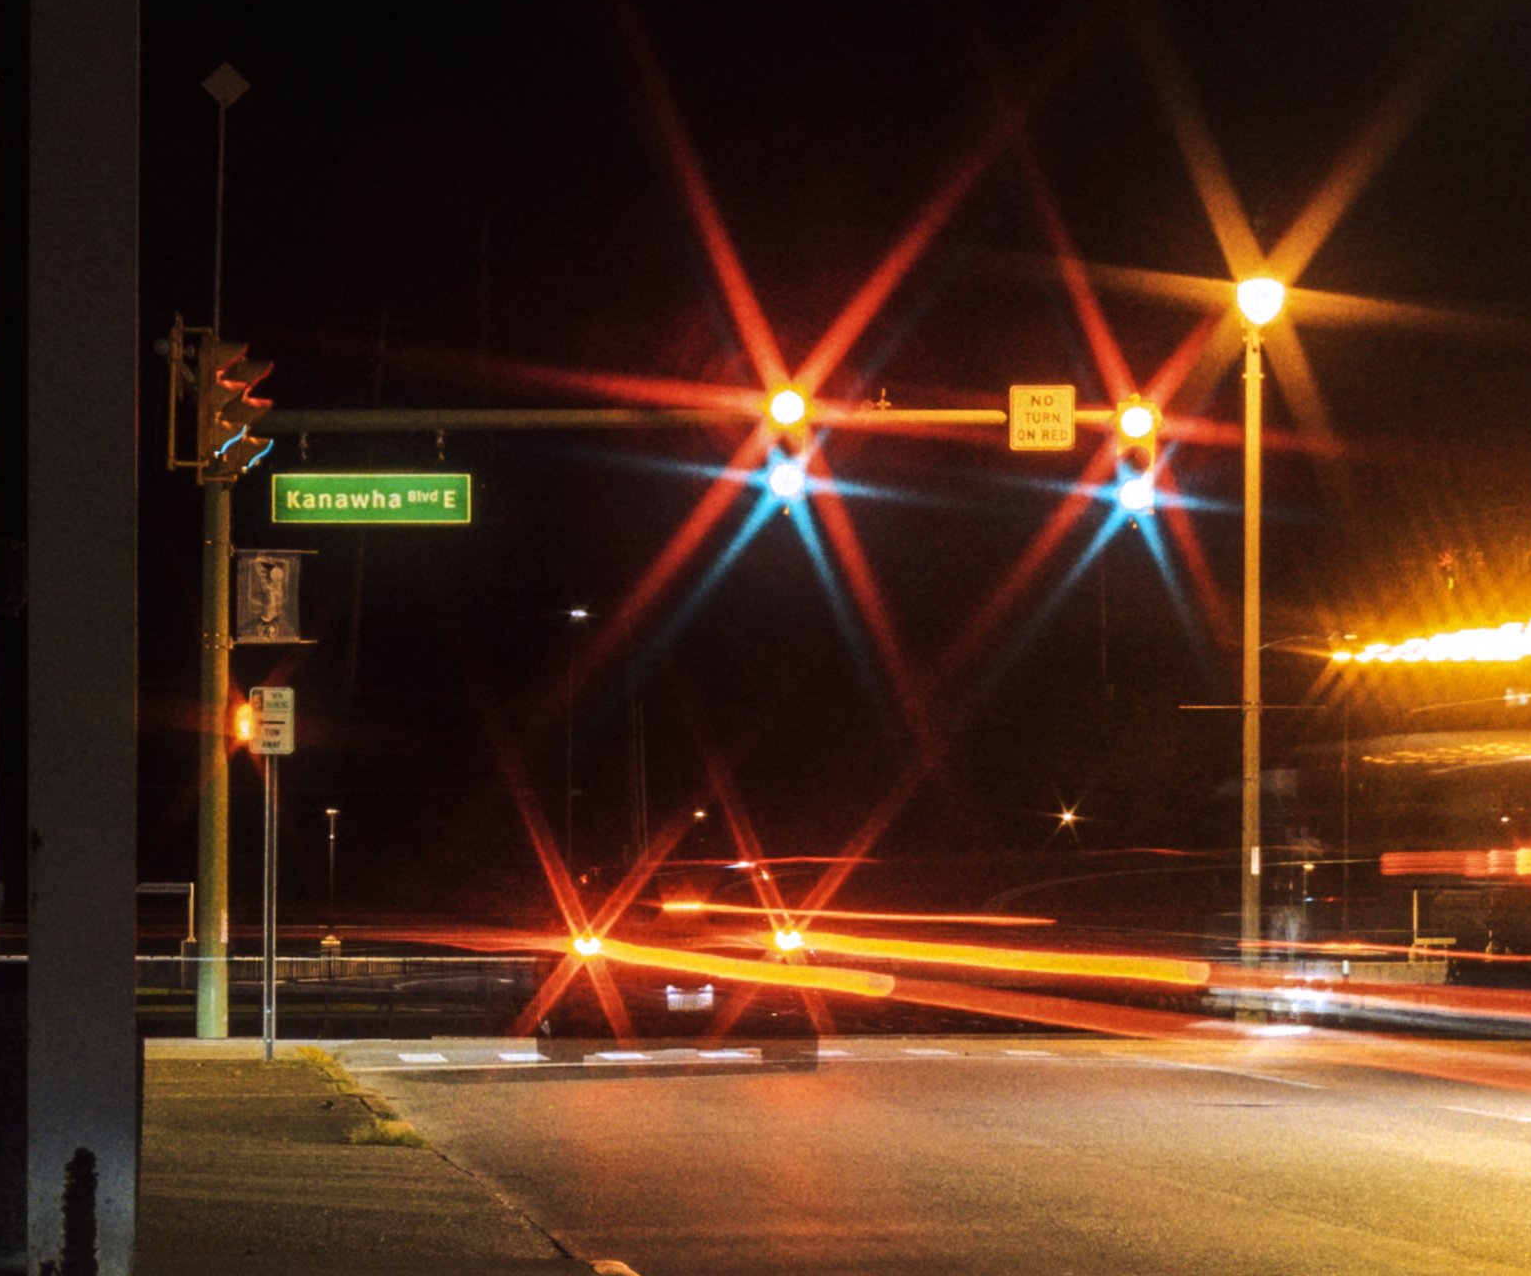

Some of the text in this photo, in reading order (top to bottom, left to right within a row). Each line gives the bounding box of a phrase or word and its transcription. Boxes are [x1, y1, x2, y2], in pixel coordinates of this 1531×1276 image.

[1031, 395, 1054, 407] NO
[1024, 412, 1061, 424] TURN
[1017, 429, 1069, 441] ON RED
[286, 489, 456, 509] Kanawha Blvd E
